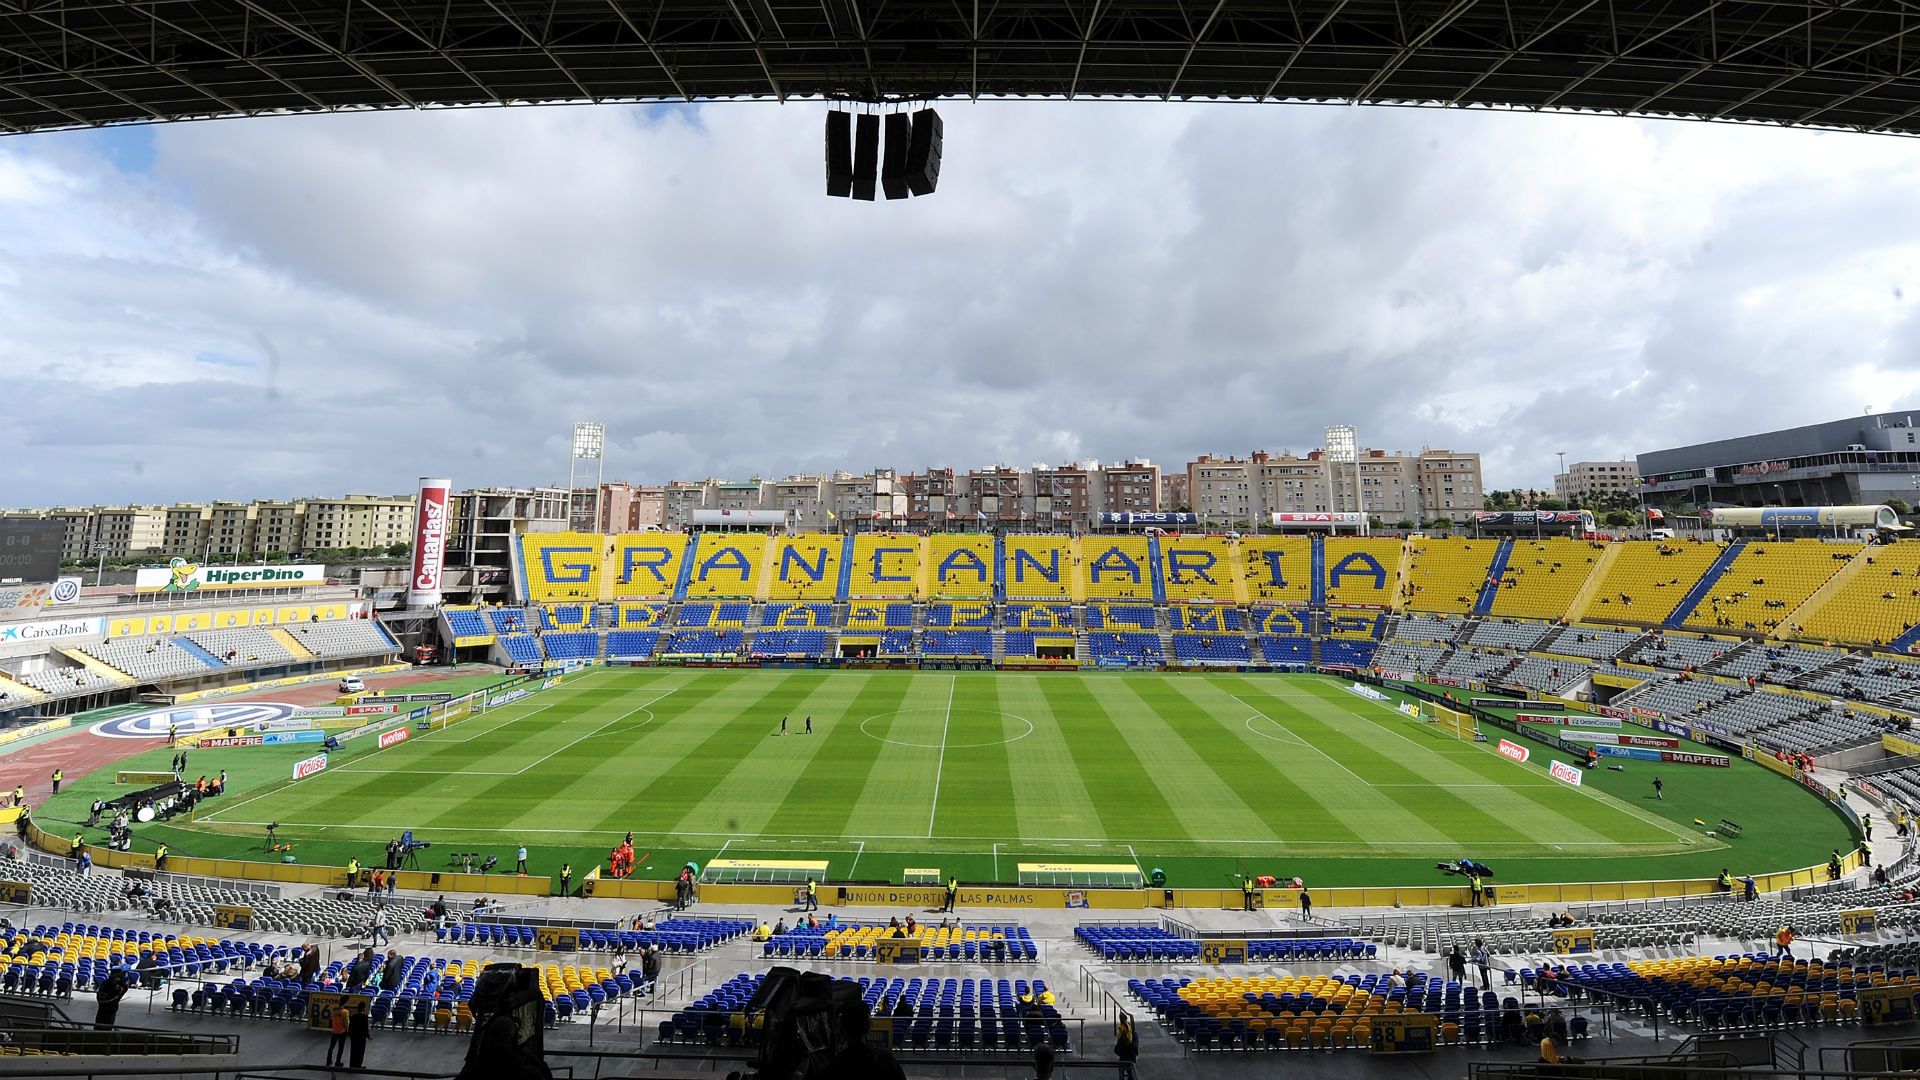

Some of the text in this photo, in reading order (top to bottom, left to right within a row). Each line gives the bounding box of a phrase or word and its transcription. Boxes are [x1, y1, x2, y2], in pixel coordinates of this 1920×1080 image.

[417, 499, 442, 589] Canarias7
[206, 568, 304, 584] HiperDino
[21, 622, 89, 639] CaixaBank
[1383, 670, 1402, 680] AVIS
[1437, 679, 1460, 688] SPAR
[1399, 700, 1419, 717] bet365
[1636, 707, 1659, 718] SPAR
[1605, 710, 1629, 721] SPAR
[1580, 719, 1620, 727] GranCanaria
[211, 737, 262, 747] MAPFRE
[382, 731, 406, 747] worten
[1629, 737, 1668, 747] Alcampo
[1499, 744, 1523, 759] worten
[1610, 747, 1630, 756] FSM
[1673, 753, 1729, 766] MAPFRE
[298, 757, 326, 778] Kalise
[1552, 763, 1577, 783] Kalise
[846, 890, 1033, 905] UNIÓN DEPORTIV LAS PALMAS
[217, 912, 229, 924] C5
[1843, 916, 1861, 928] C10
[538, 934, 553, 945] C6
[1555, 938, 1570, 949] C9
[878, 946, 894, 958] C7
[1204, 947, 1219, 958] C8
[312, 1003, 332, 1019] B6
[1863, 1000, 1882, 1015] B9
[1373, 1027, 1395, 1042] B8
